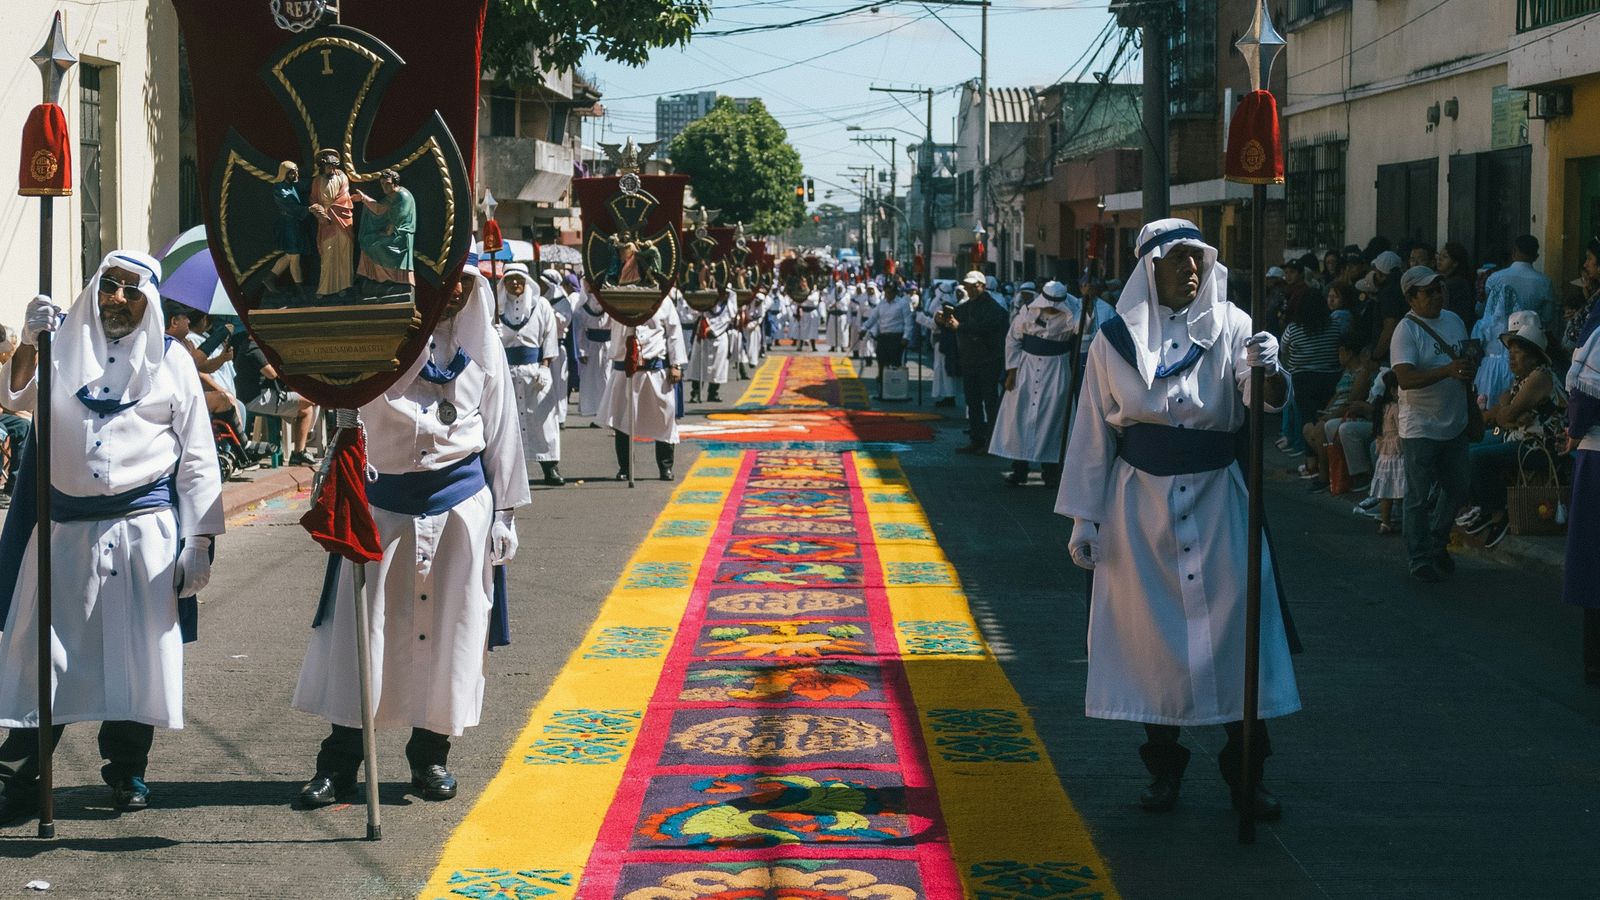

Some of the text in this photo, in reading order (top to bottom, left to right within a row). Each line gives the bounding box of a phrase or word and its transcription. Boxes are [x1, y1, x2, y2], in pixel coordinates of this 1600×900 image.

[286, 0, 312, 17] REY
[320, 49, 334, 75] I
[625, 198, 636, 208] II
